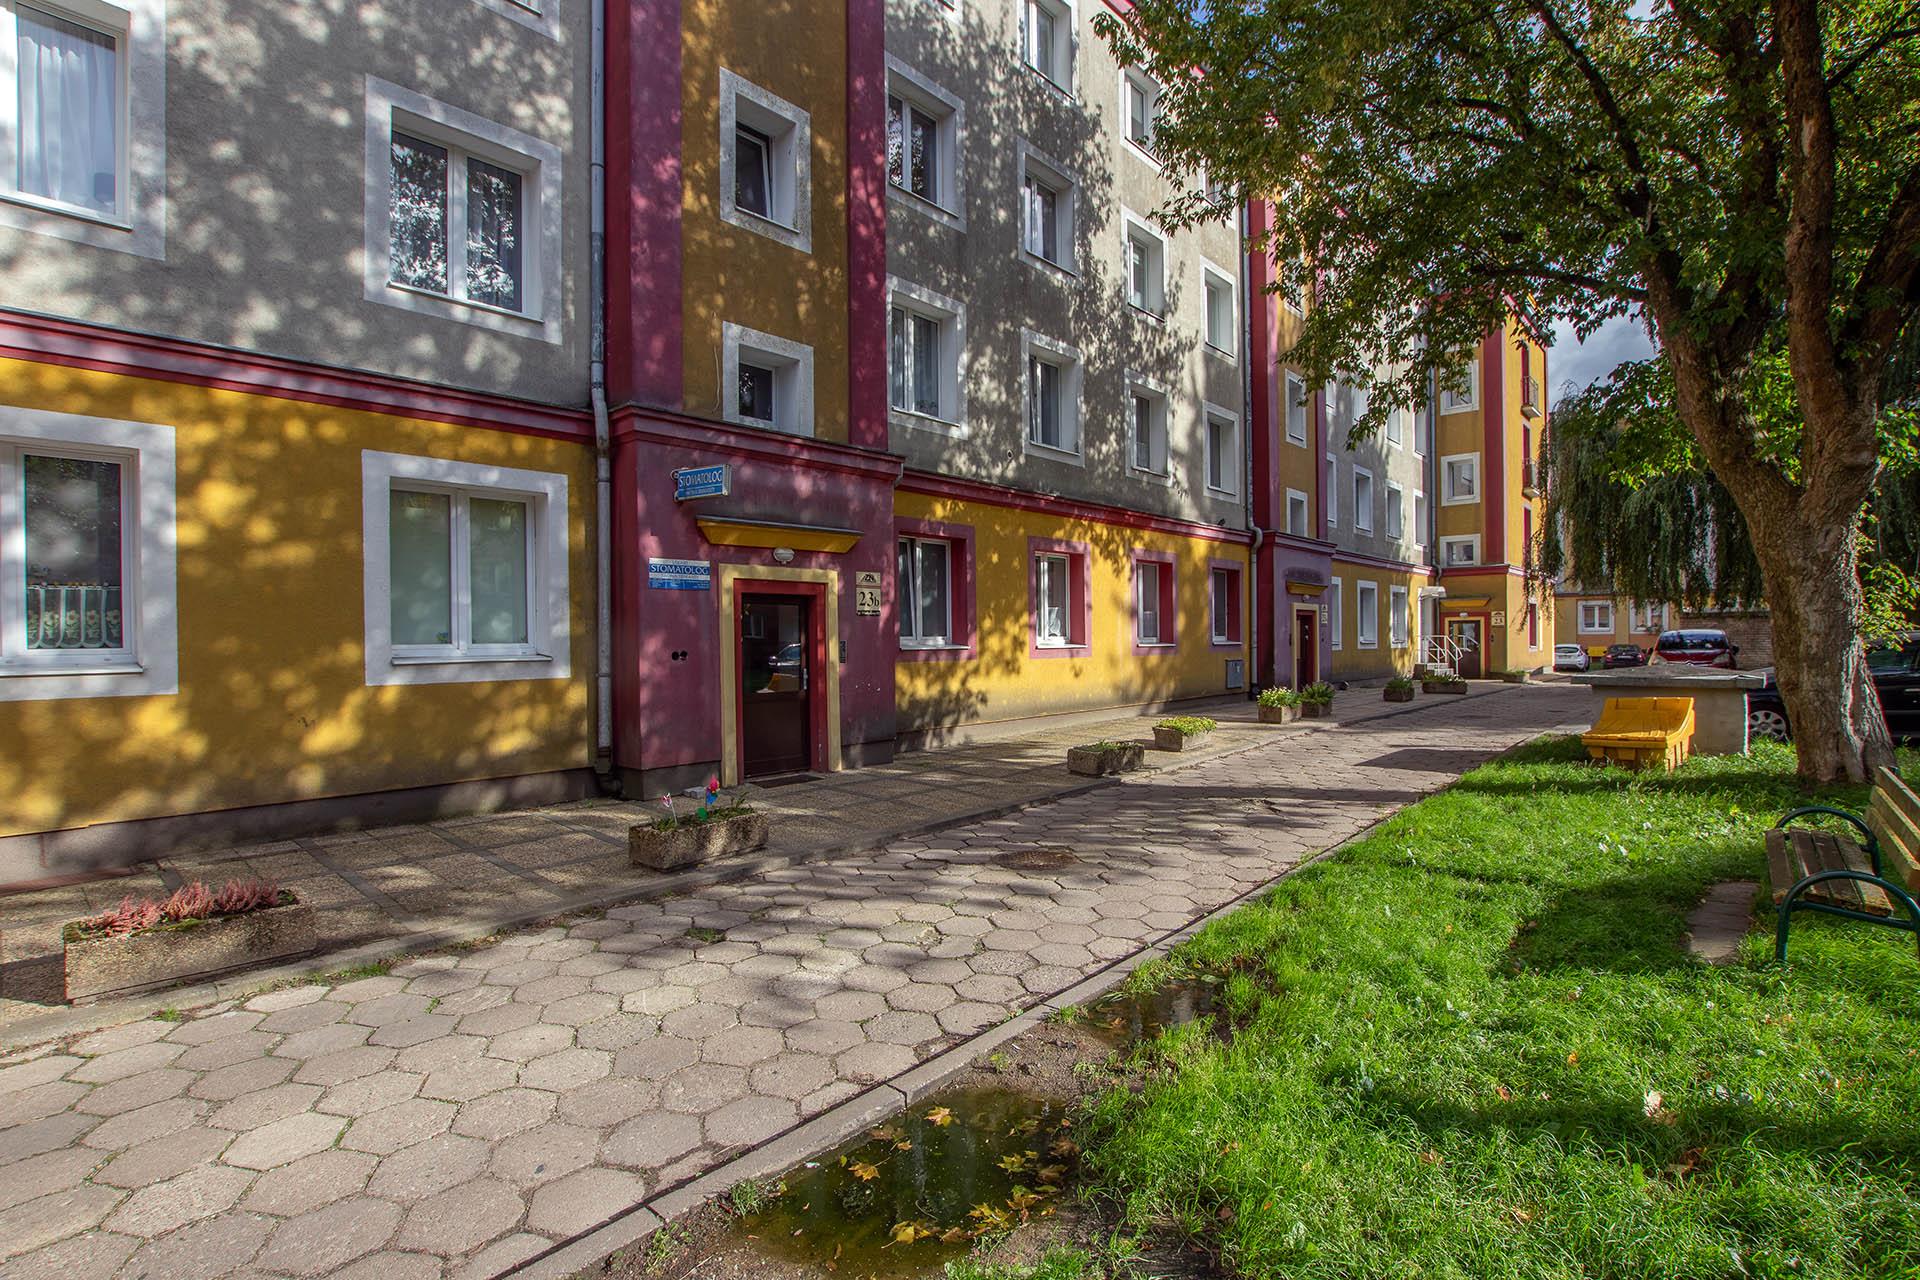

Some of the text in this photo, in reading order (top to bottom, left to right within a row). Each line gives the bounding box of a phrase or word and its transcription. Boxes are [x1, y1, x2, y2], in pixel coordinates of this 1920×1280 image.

[679, 470, 723, 487] STOMATOLOG
[650, 564, 709, 575] STOMATOLOG
[859, 591, 880, 607] 23b
